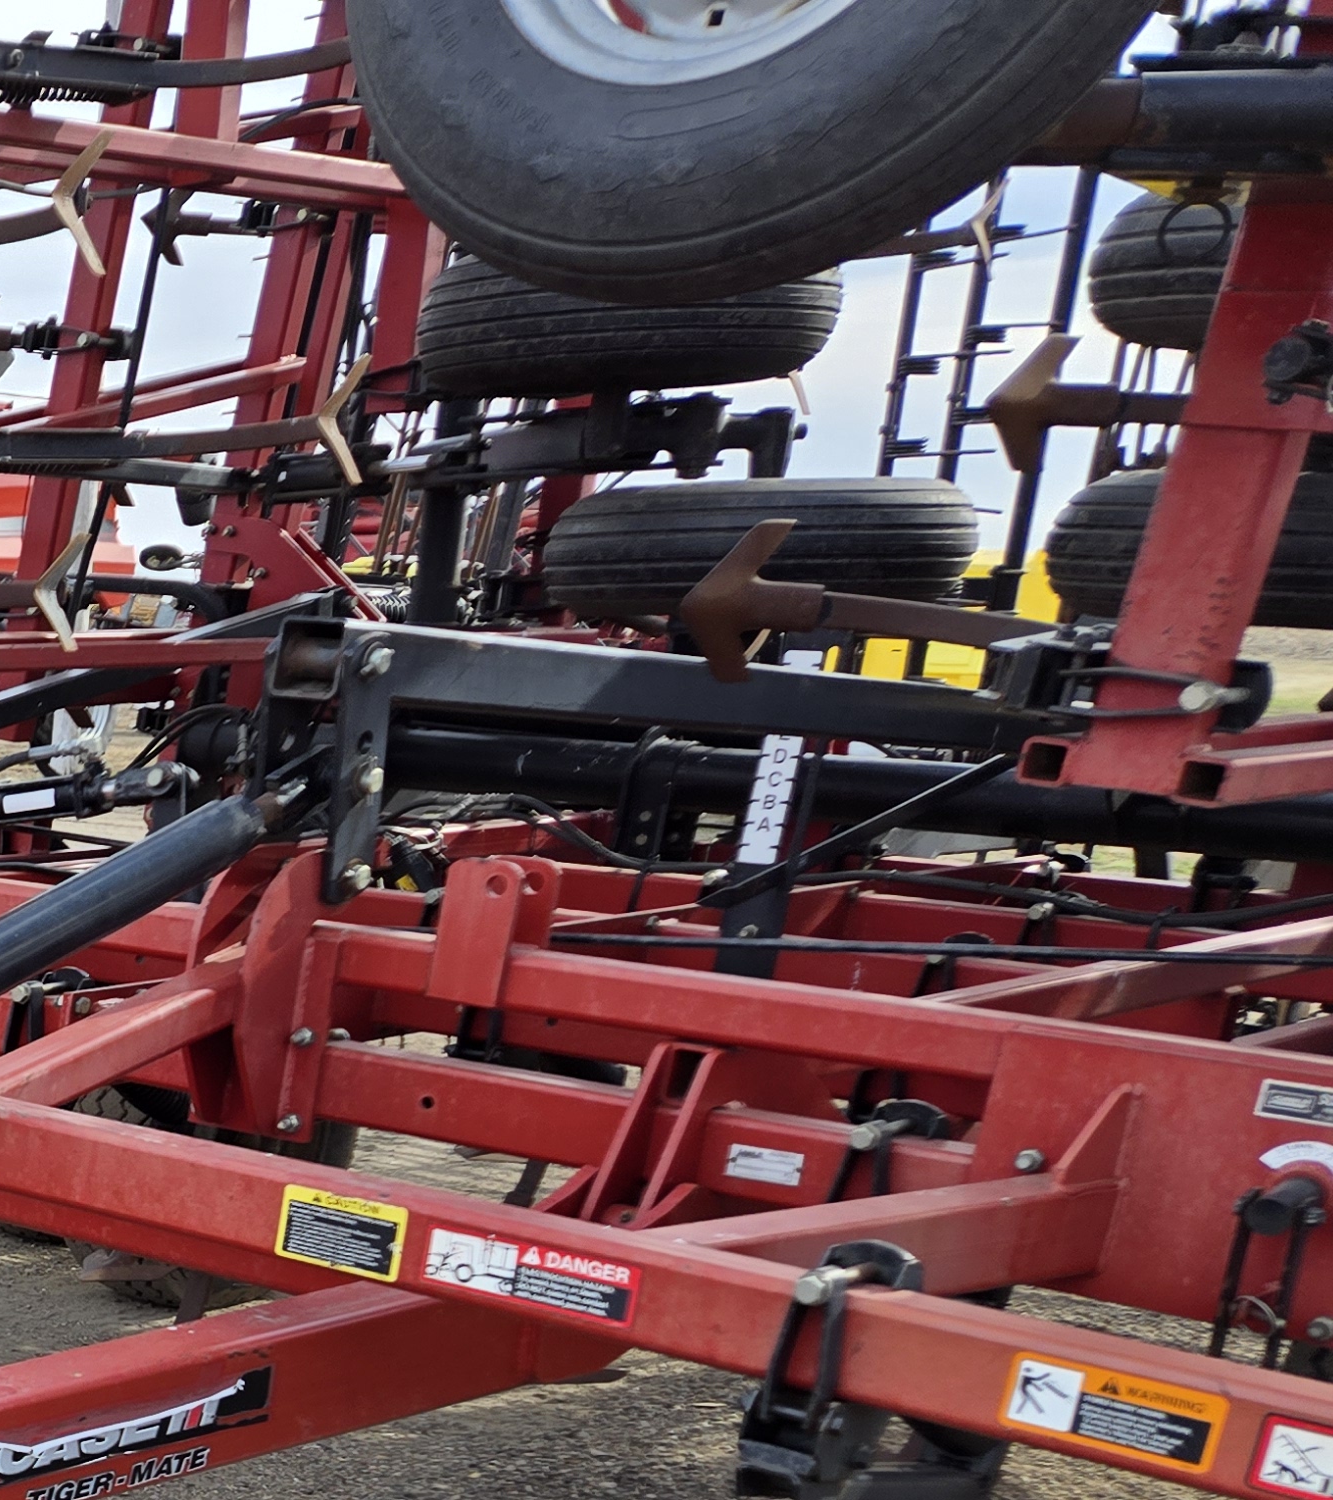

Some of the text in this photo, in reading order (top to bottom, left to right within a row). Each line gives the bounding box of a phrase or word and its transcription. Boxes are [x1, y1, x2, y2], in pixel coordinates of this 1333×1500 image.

[773, 748, 787, 764] D
[768, 771, 782, 787] C
[763, 794, 776, 810] B
[756, 816, 770, 832] A
[544, 1251, 630, 1284] DANGER
